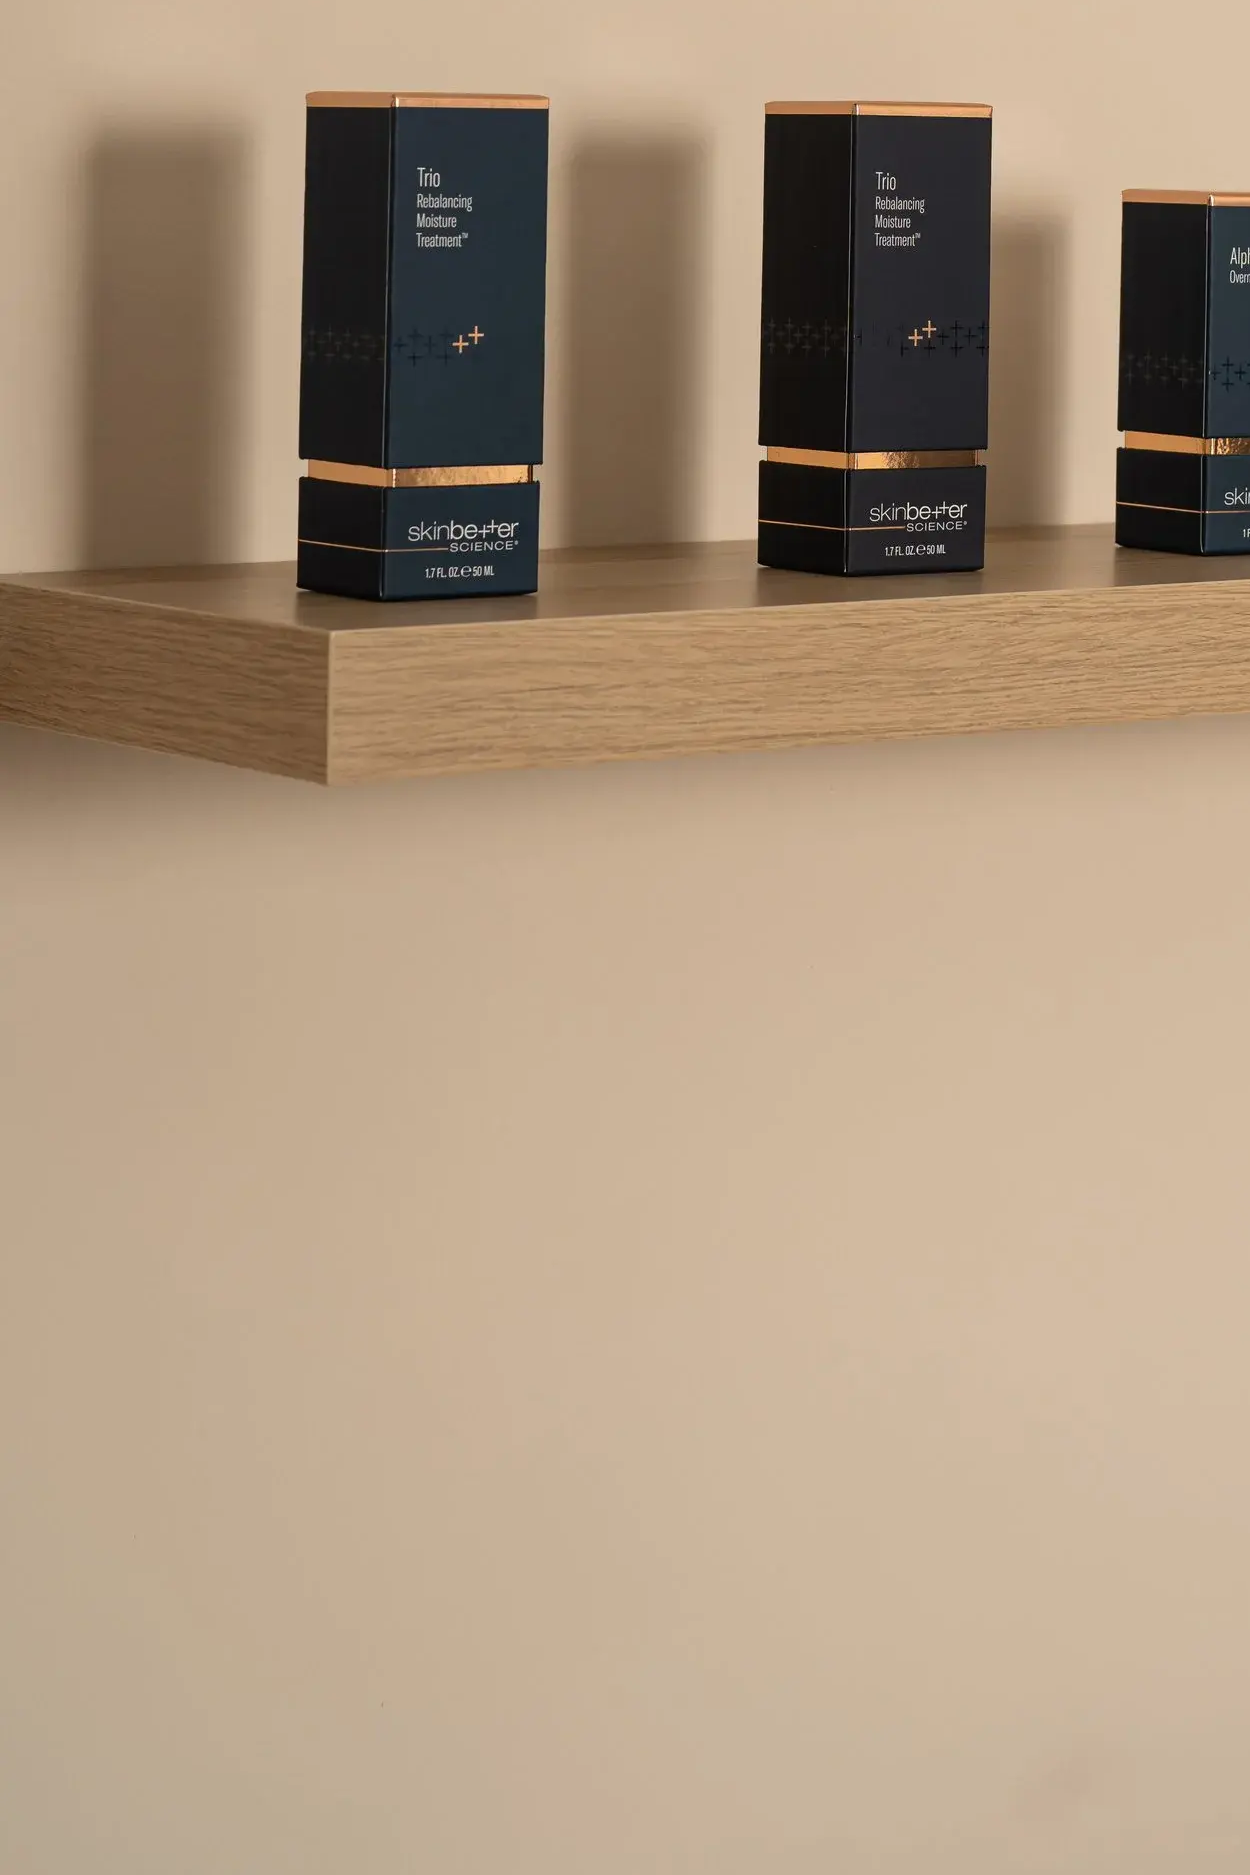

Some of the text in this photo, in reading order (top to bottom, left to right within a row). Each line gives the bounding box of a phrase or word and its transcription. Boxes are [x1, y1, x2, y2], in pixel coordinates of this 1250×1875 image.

[417, 167, 440, 187] Trio
[876, 171, 896, 191] Trio
[417, 193, 472, 212] Rebalancing
[875, 196, 925, 213] Rebalancing
[416, 213, 457, 228] Moisture
[874, 215, 911, 229] Moisture
[884, 547, 894, 557] 1.7
[894, 547, 904, 556] FL.
[906, 546, 916, 555] OZ.
[926, 545, 935, 555] 50
[936, 545, 946, 554] ML
[425, 567, 436, 578] 1.7
[436, 567, 447, 578] FL.
[448, 567, 460, 578] OZ.
[472, 566, 482, 577] 50
[484, 565, 495, 576] ML
